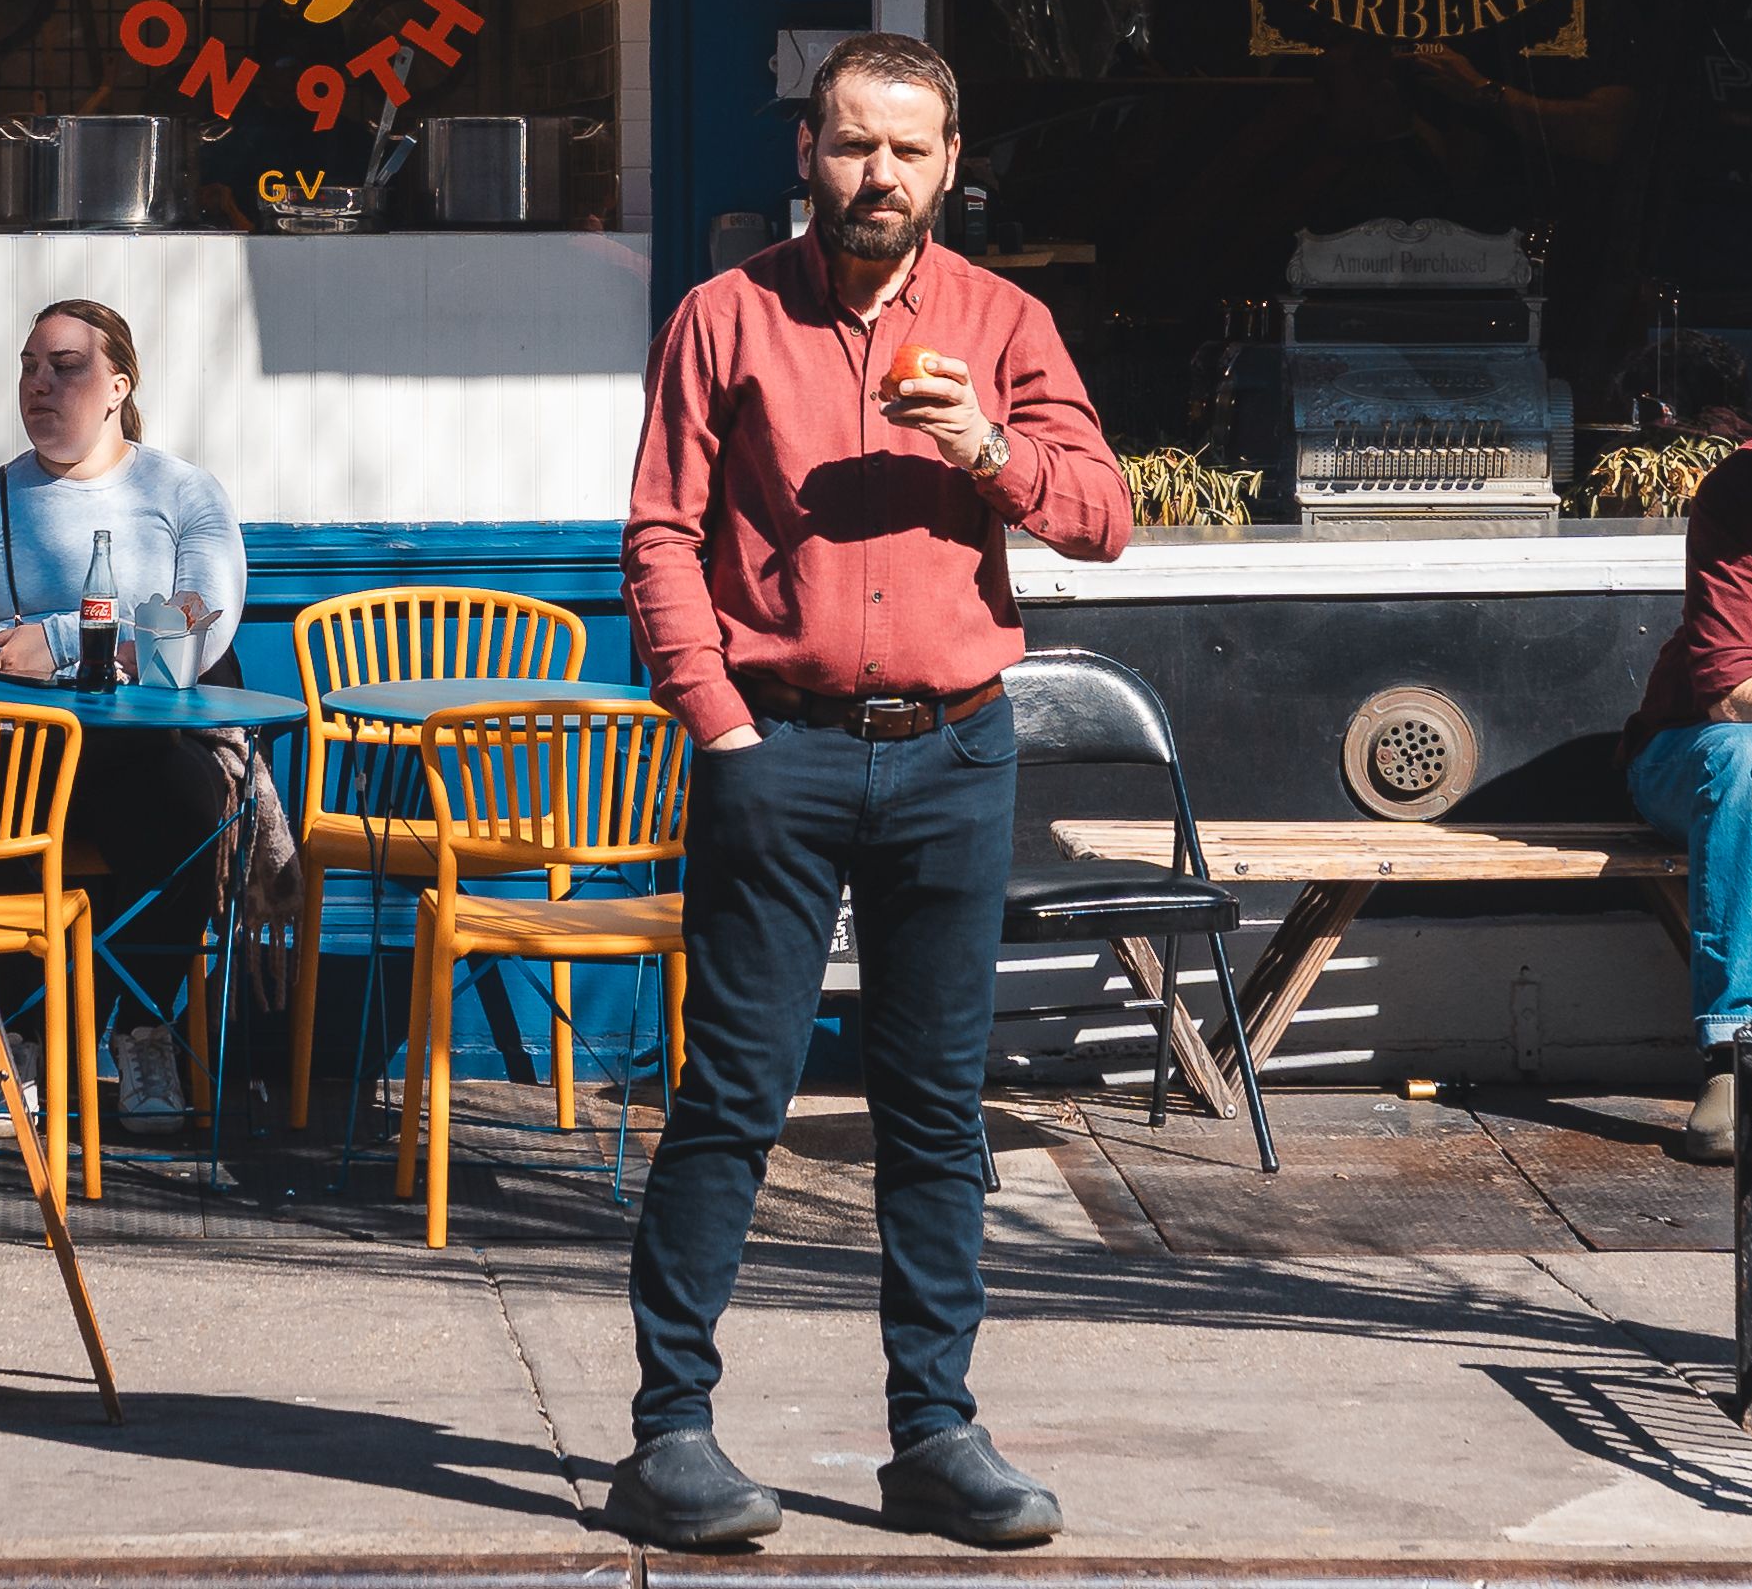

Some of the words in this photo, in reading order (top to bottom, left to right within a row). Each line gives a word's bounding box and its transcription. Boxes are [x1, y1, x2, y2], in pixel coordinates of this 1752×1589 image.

[119, 0, 260, 120] ON
[1331, 253, 1394, 275] Amount
[1400, 250, 1488, 275] Purchased
